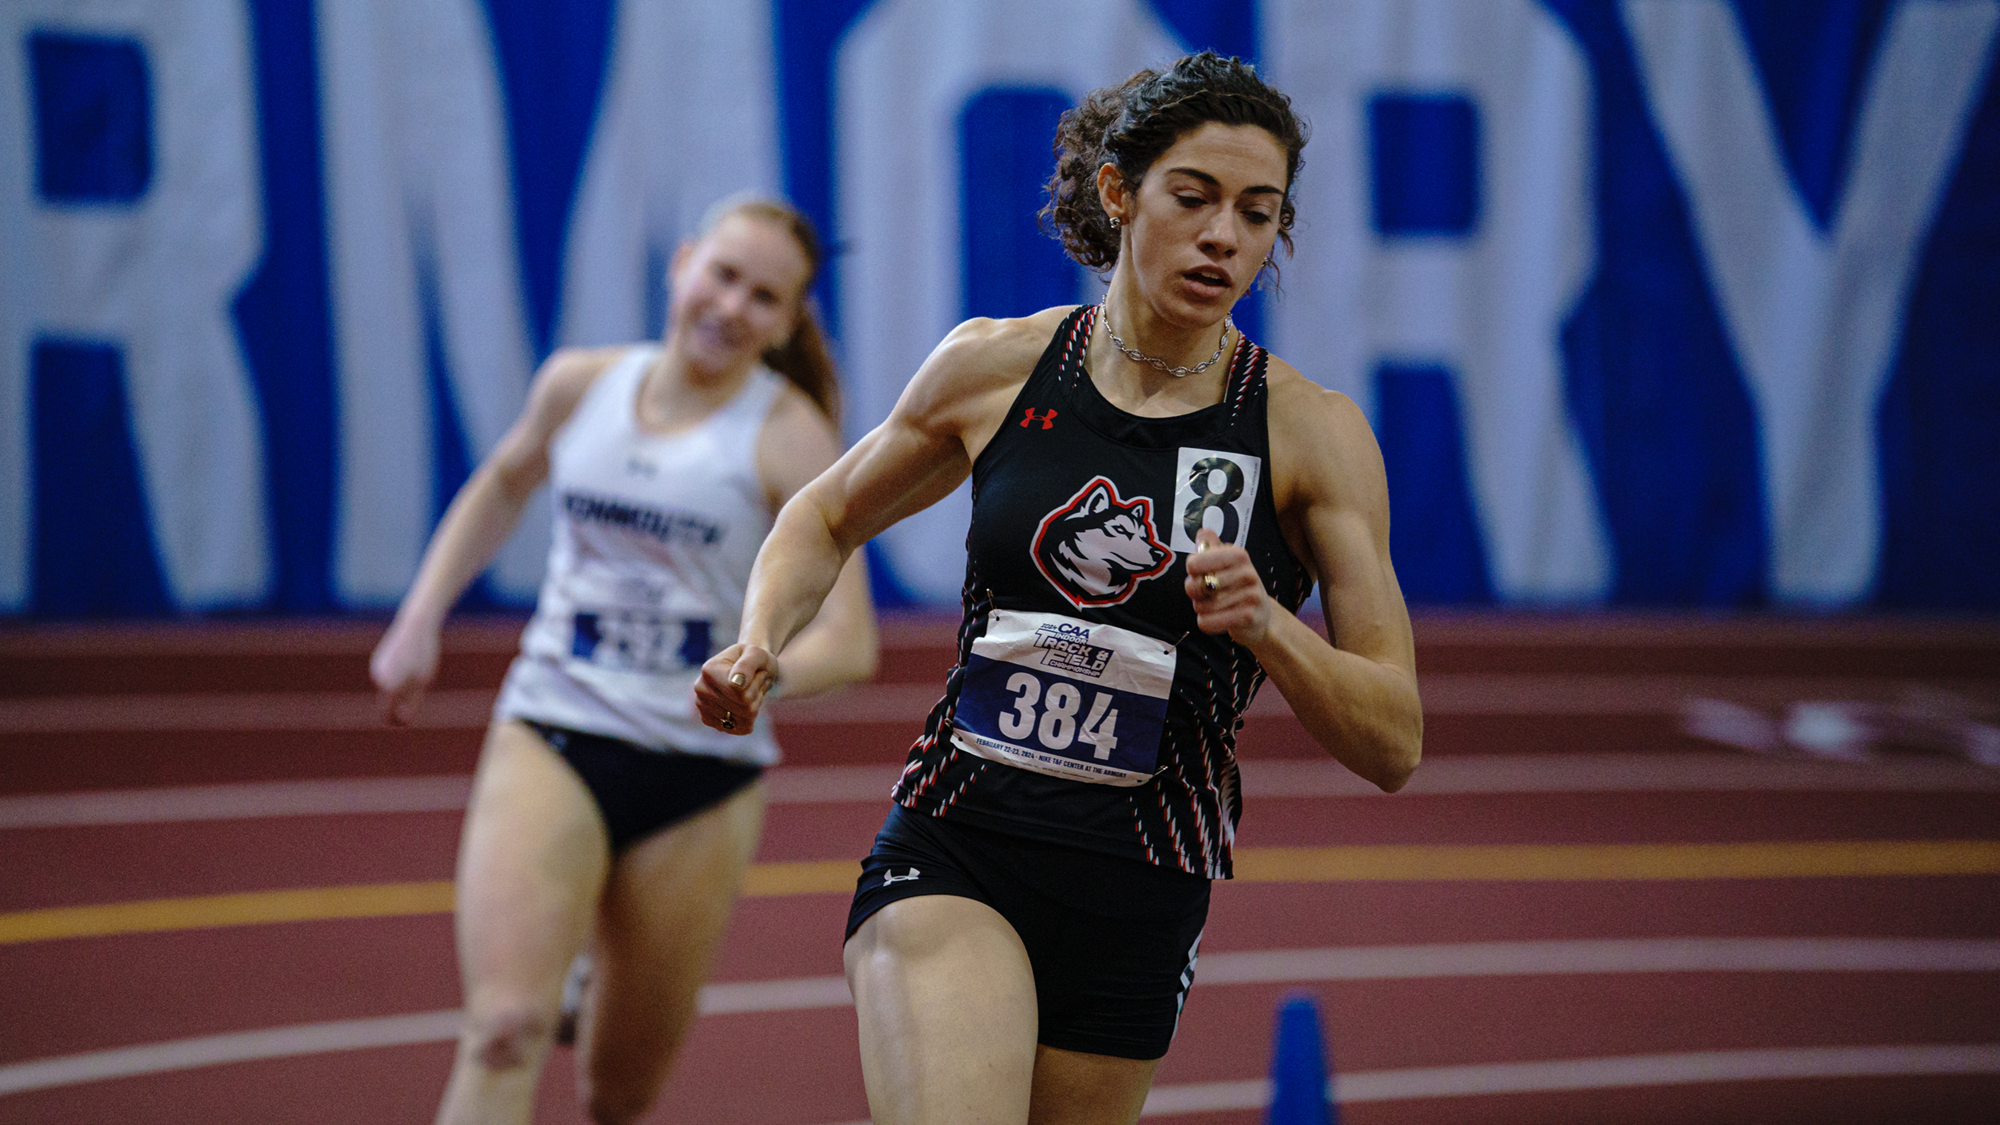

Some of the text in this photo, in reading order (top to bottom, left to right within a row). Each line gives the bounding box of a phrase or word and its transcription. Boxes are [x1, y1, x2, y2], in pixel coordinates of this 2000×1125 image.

[1184, 457, 1245, 548] 8
[1034, 628, 1109, 661] TRACK &
[1055, 633, 1088, 645] INDOOR
[1058, 623, 1090, 639] CAA
[1040, 648, 1106, 671] FIELD
[998, 672, 1118, 761] 384
[976, 738, 1004, 750] FEBRUARY
[1021, 750, 1034, 759] 2024
[1039, 755, 1052, 764] NIKE
[1063, 760, 1084, 770] CENTER
[1104, 769, 1127, 778] ARMORY
